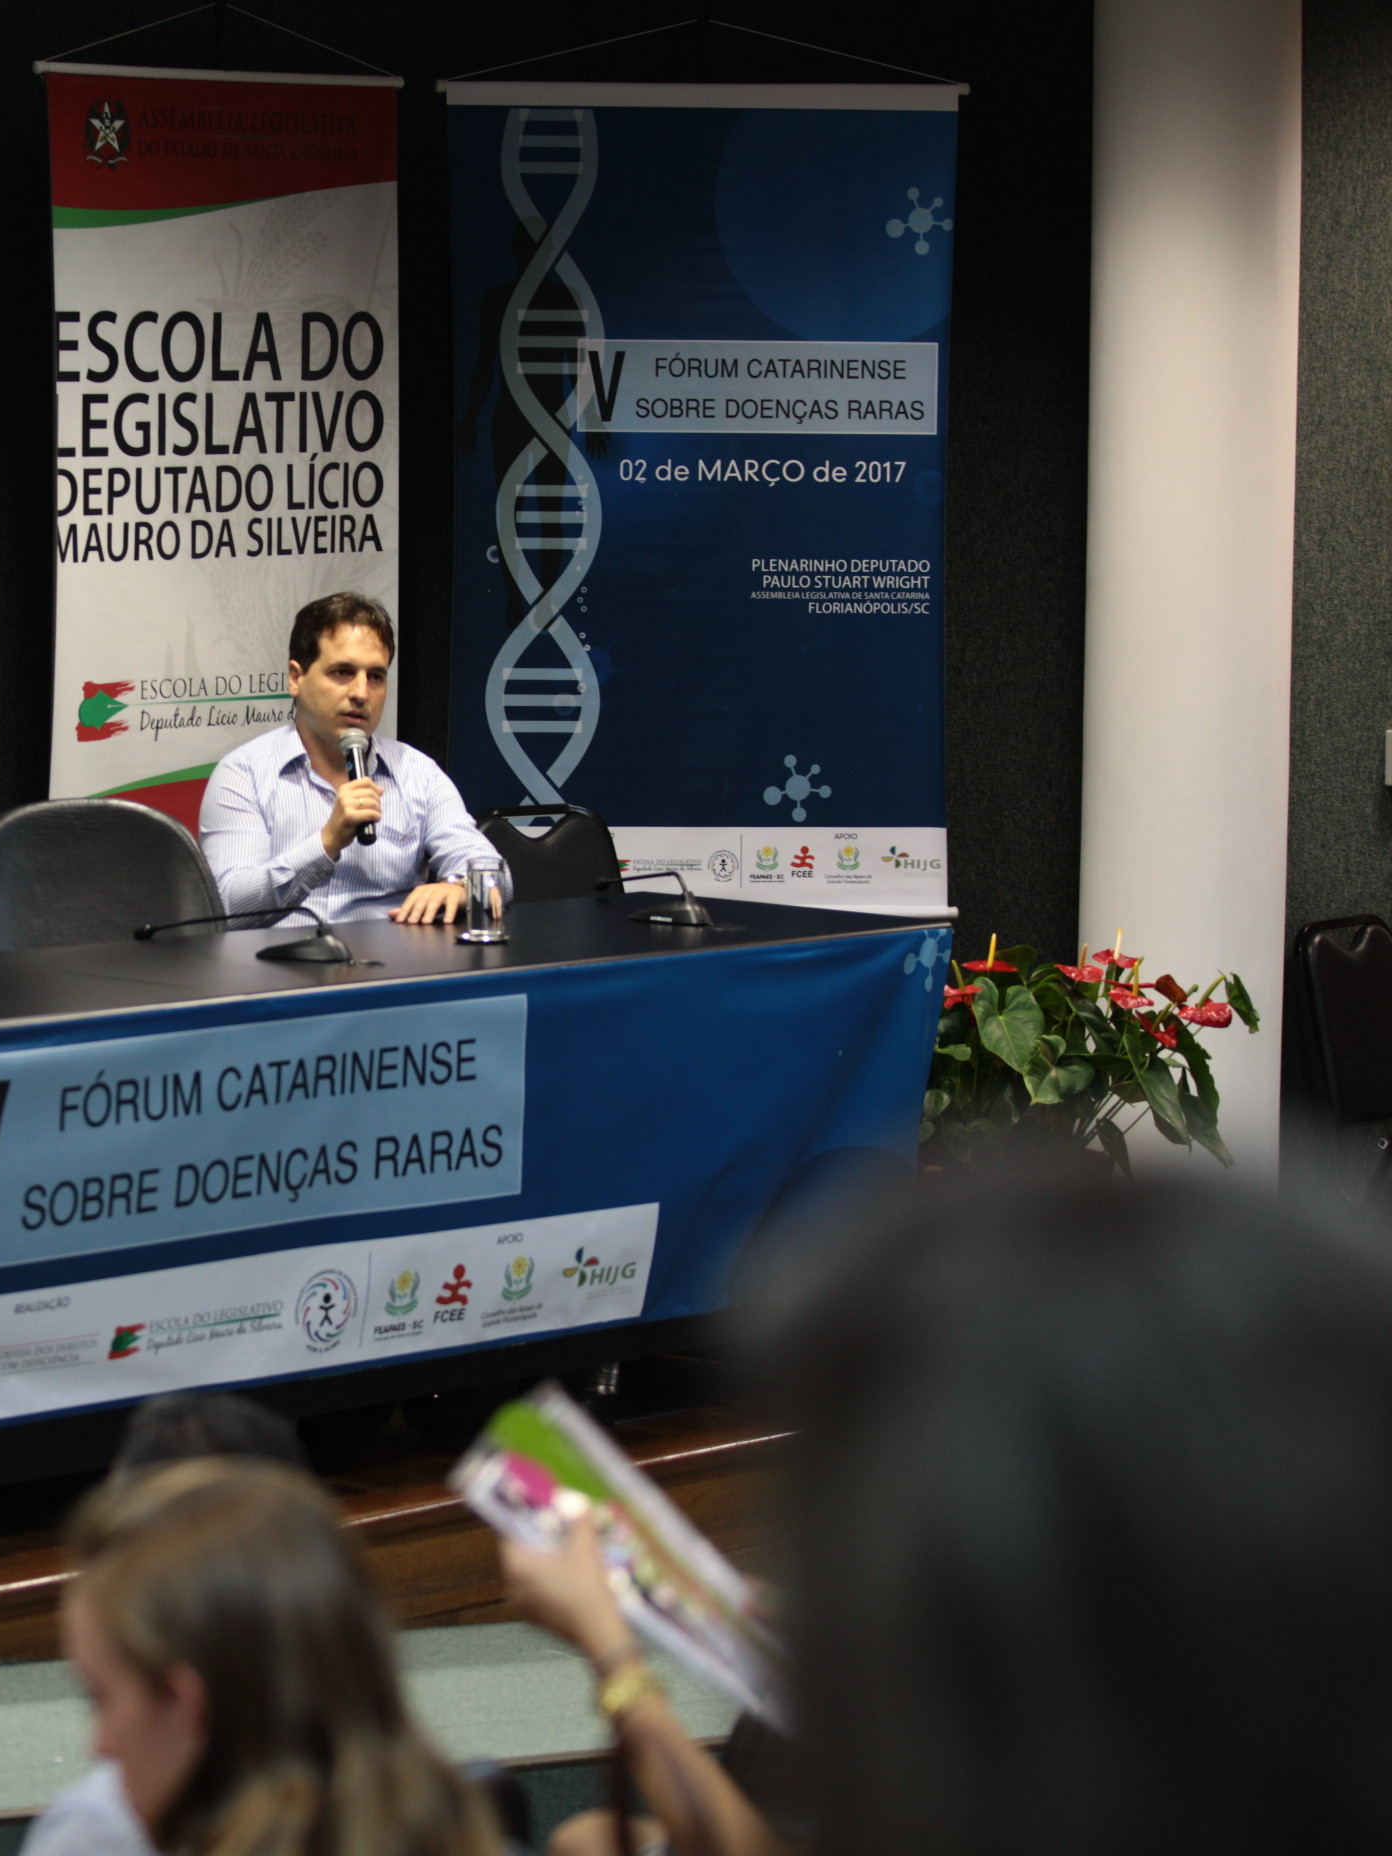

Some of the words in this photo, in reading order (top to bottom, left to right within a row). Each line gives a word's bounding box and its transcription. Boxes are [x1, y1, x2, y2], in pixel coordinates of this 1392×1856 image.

[138, 107, 244, 132] ASSEMBLEIA
[251, 111, 358, 135] LEGISLATIVA
[137, 140, 160, 157] DO
[164, 141, 218, 159] ESTADO
[221, 142, 240, 159] DE
[244, 143, 287, 160] SANTA
[290, 144, 359, 162] CATARINA
[55, 310, 282, 383] ESCOLA
[300, 311, 384, 381] DO
[654, 353, 740, 379] FÓRUM
[746, 358, 907, 380] CATARINENSE
[587, 350, 626, 422] V
[635, 398, 716, 419] SOBRE
[725, 398, 839, 425] DOENÇAS
[847, 400, 925, 421] RARAS
[57, 463, 274, 517] DEPUTADO
[286, 453, 384, 510] LÍCIO
[619, 459, 648, 482] 02
[654, 459, 690, 482] de
[697, 459, 806, 487] MARÇO
[812, 460, 848, 483] de
[854, 461, 908, 484] 2017
[57, 520, 181, 564] MAURO
[190, 518, 237, 560] DA
[246, 513, 384, 557] SILVEIRA
[751, 558, 848, 572] PLENARINHO
[850, 559, 931, 573] DEPUTADO
[762, 575, 812, 589] PAULO
[813, 575, 871, 589] STUART
[872, 576, 931, 589] WRIGHT
[750, 591, 801, 600] ASSEMBLEIA
[801, 591, 851, 600] LEGISLATIVA
[852, 592, 863, 600] DE
[864, 592, 890, 600] SANTA
[890, 592, 931, 600] CATARINA
[807, 600, 931, 615] FLORIANÓPOLIS/SC
[139, 677, 209, 700] ESCOLA
[214, 674, 242, 696] DO
[139, 705, 202, 742] Deputado
[206, 704, 238, 727] Lício
[240, 704, 284, 727] Mauro
[833, 832, 858, 840] APOIO
[791, 870, 814, 878] FCEE
[903, 859, 942, 872] HIJG
[59, 1069, 202, 1132] FÓRUM
[216, 1038, 477, 1113] CATARINENSE
[21, 1167, 161, 1231] SOBRE
[174, 1140, 358, 1208] DOENÇAS
[374, 1124, 504, 1180] RARAS
[496, 1232, 524, 1245] APOIO
[589, 1261, 637, 1286] HIJG
[148, 1316, 189, 1332] ESCOLA
[192, 1311, 212, 1325] DO
[213, 1300, 284, 1321] LEGISLATIVO
[373, 1322, 407, 1335] FEAPAES
[412, 1319, 425, 1329] SC
[433, 1308, 466, 1324] FCEE
